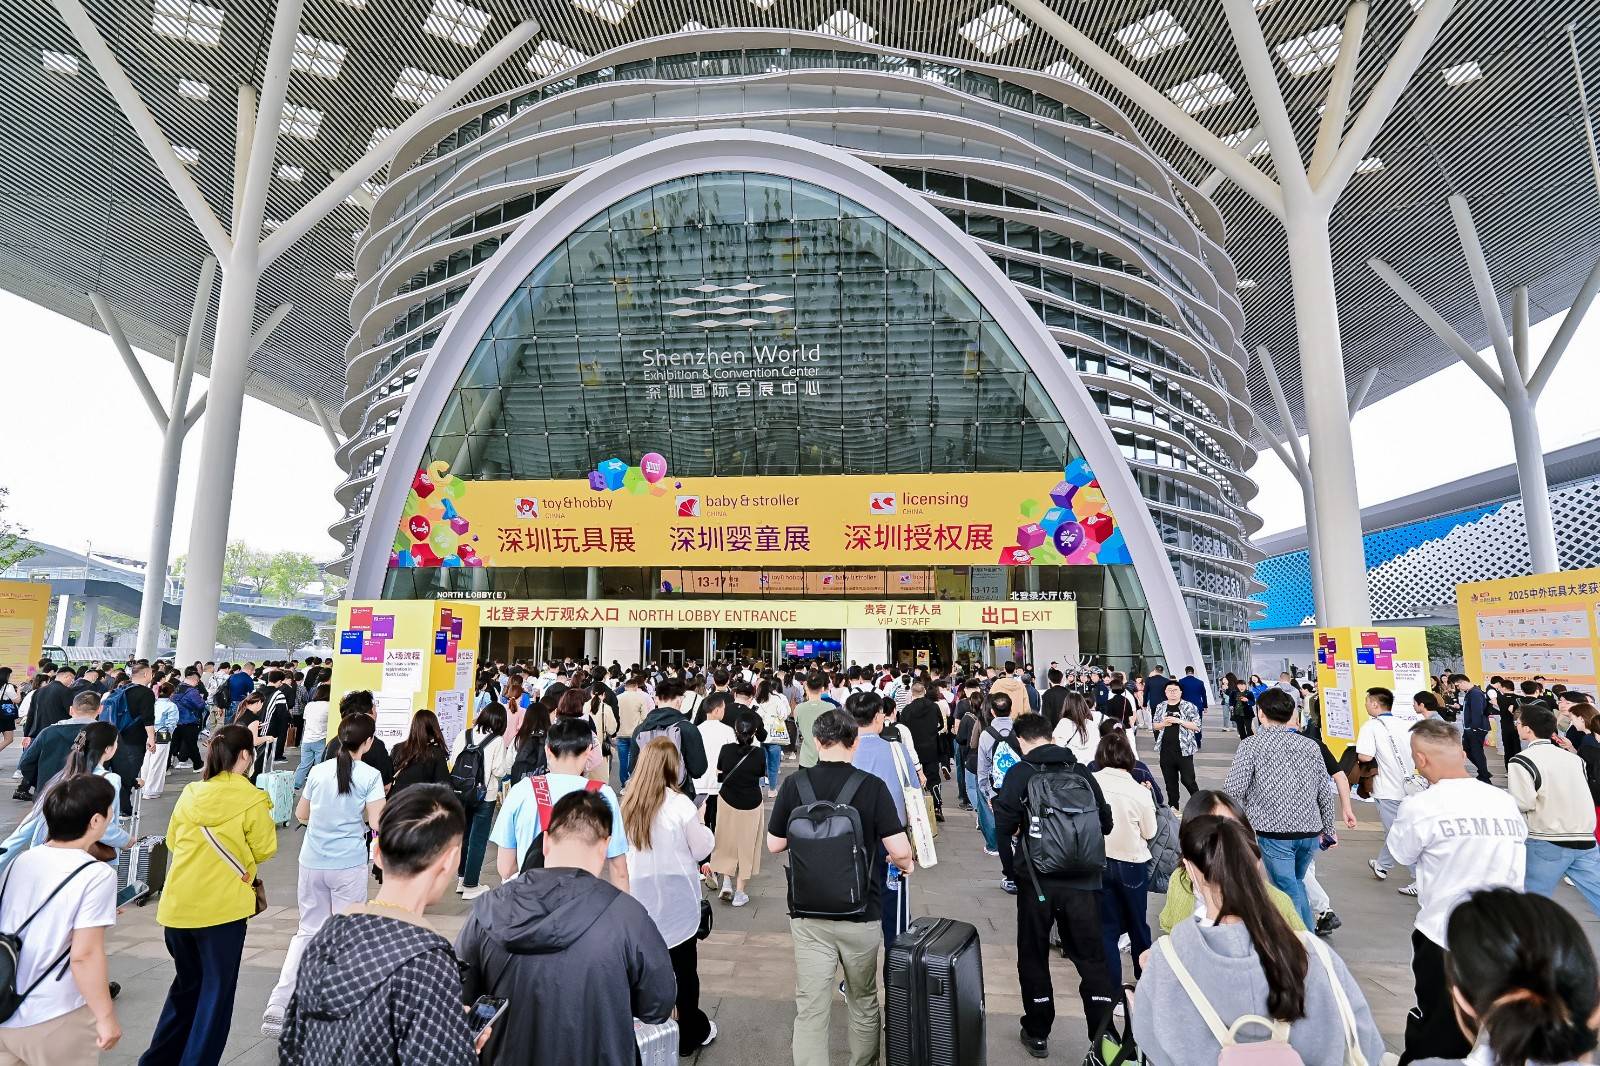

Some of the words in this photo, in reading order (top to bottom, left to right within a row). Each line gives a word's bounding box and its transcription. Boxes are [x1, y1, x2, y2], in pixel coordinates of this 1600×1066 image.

[642, 348, 745, 367] Shenzhen
[753, 343, 821, 365] World
[644, 369, 699, 381] Exhibition
[702, 369, 712, 380] &
[714, 367, 779, 379] Convention
[781, 366, 821, 377] Center
[646, 380, 821, 400] 深圳国际会展中心
[706, 495, 738, 509] baby
[740, 494, 750, 506] &
[752, 494, 800, 507] stroller
[903, 492, 969, 508] licensing
[497, 526, 636, 553] 深圳玩具展
[669, 525, 811, 552] 深圳婴童展
[844, 523, 993, 551] 深圳授权展
[437, 591, 464, 599] NORTH
[1508, 581, 1600, 601] 2025中外玩具大奖获
[486, 606, 619, 622] 北登录大厅观众入口
[628, 609, 674, 622] NORTH
[678, 609, 721, 622] LOBBY
[725, 610, 797, 622] ENTRANCE
[864, 604, 887, 616] 贵宾
[896, 604, 942, 616] 工作人员
[981, 606, 1019, 625] 出口
[1022, 610, 1053, 622] EXIT
[877, 617, 893, 626] VIP
[900, 617, 931, 626] STAFF
